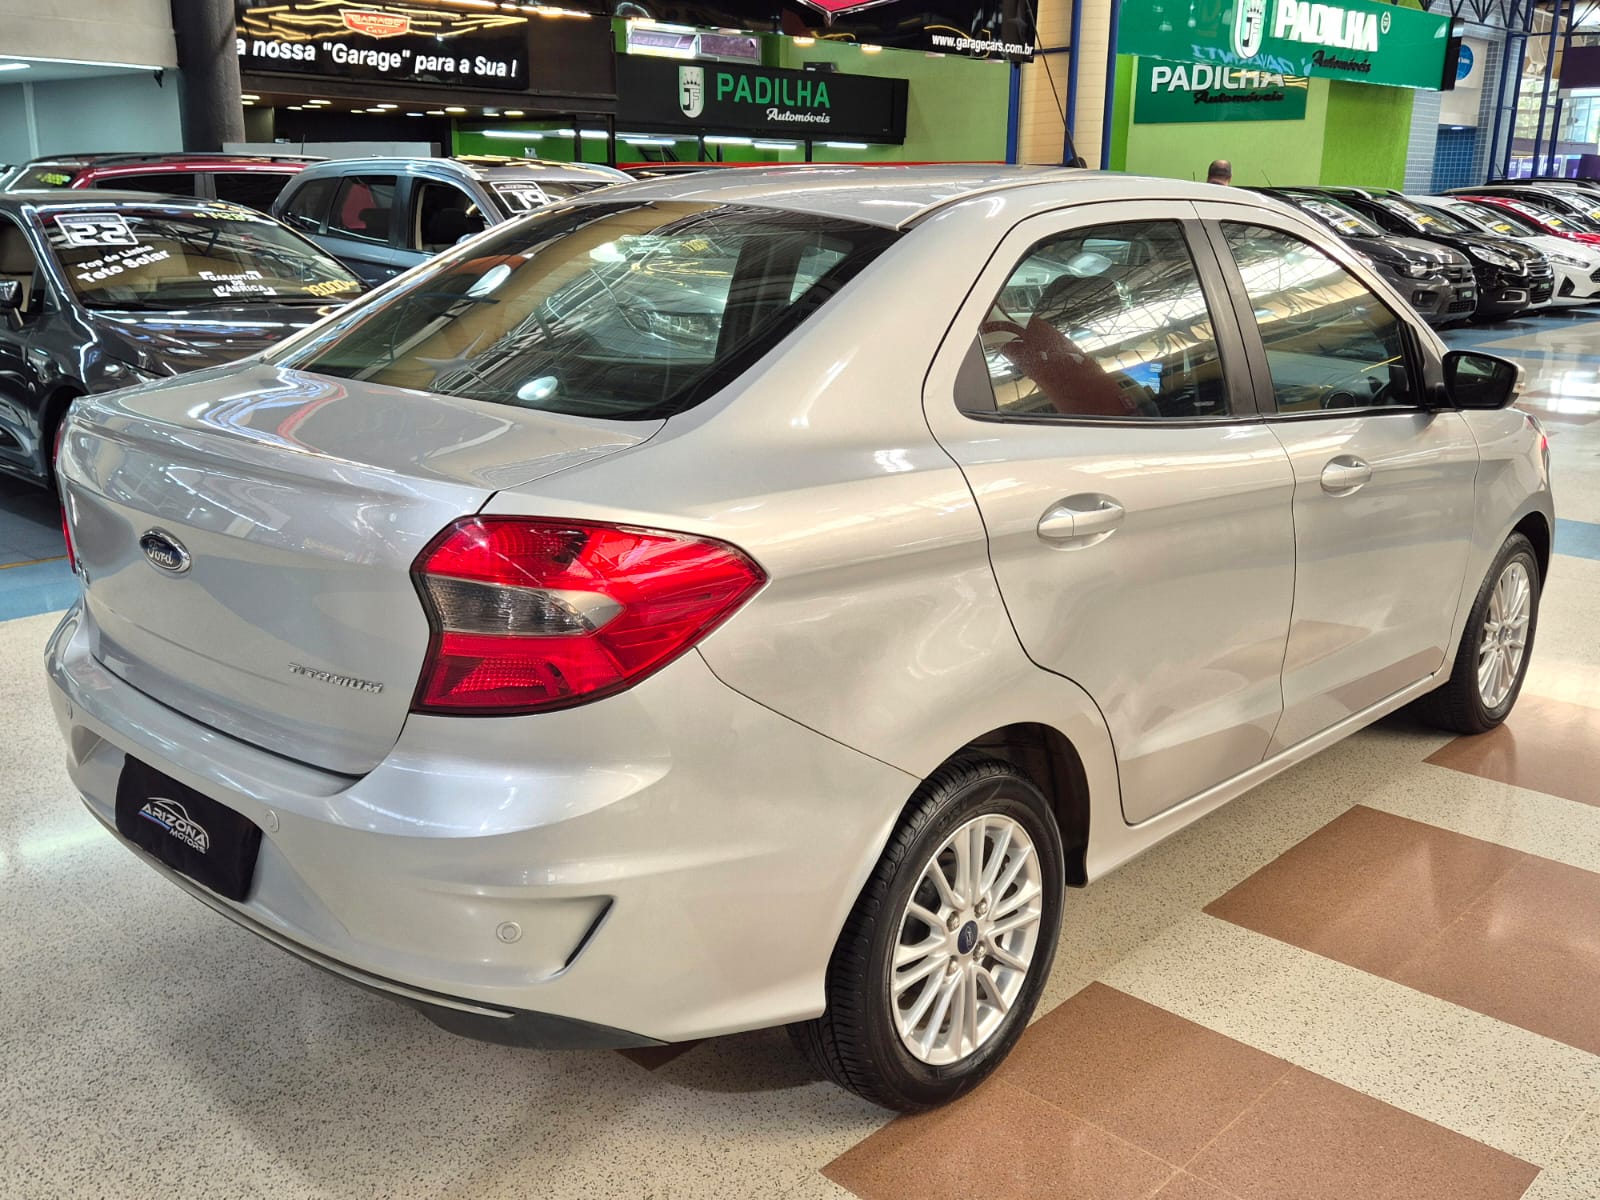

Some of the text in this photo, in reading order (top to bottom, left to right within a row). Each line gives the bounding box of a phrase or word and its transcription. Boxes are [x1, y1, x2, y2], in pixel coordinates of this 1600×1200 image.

[1272, 0, 1378, 52] PADILHA
[252, 40, 315, 61] nossa
[323, 42, 410, 73] "Garage"
[415, 53, 455, 75] para
[459, 60, 470, 74] a
[474, 57, 507, 77] Sua
[931, 34, 1034, 55] www.garagecars.com.br
[717, 72, 831, 108] PADILHA
[1151, 64, 1285, 93] PADILHA
[766, 107, 831, 124] Automóveis
[67, 223, 128, 244] 22
[76, 249, 172, 283] Teto Solar
[77, 259, 103, 270] Top
[118, 244, 155, 258] Linha
[146, 538, 174, 565] Ford
[288, 662, 384, 694] TITANIUM
[140, 803, 207, 847] ARIZONA
[169, 829, 208, 855] MOTORS
